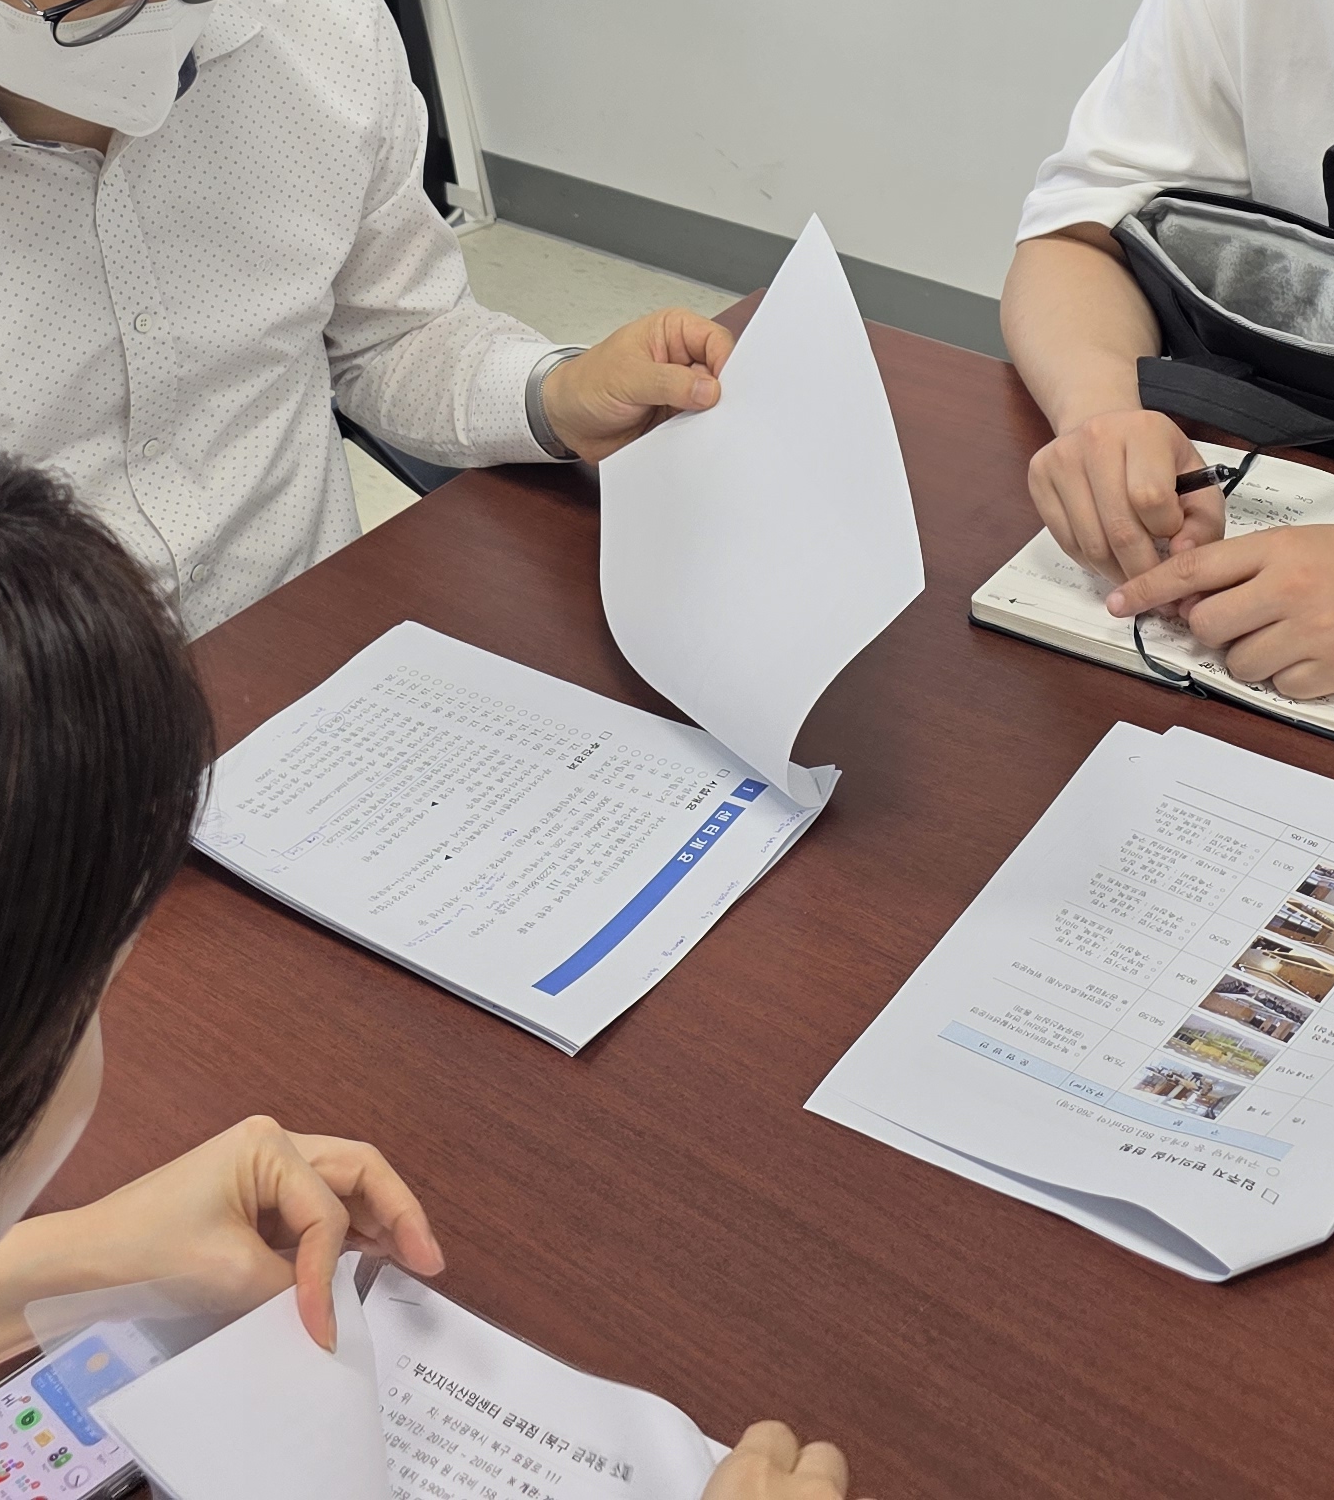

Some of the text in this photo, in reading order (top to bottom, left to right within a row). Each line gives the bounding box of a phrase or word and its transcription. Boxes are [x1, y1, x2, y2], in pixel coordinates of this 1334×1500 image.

[683, 779, 719, 812] 시설개요
[1118, 1141, 1147, 1156] 현황
[1150, 1149, 1207, 1173] 편의시설
[411, 1361, 502, 1420] 부산지식산업센터
[502, 1412, 540, 1439] 금곡점
[539, 1431, 570, 1454] (북구
